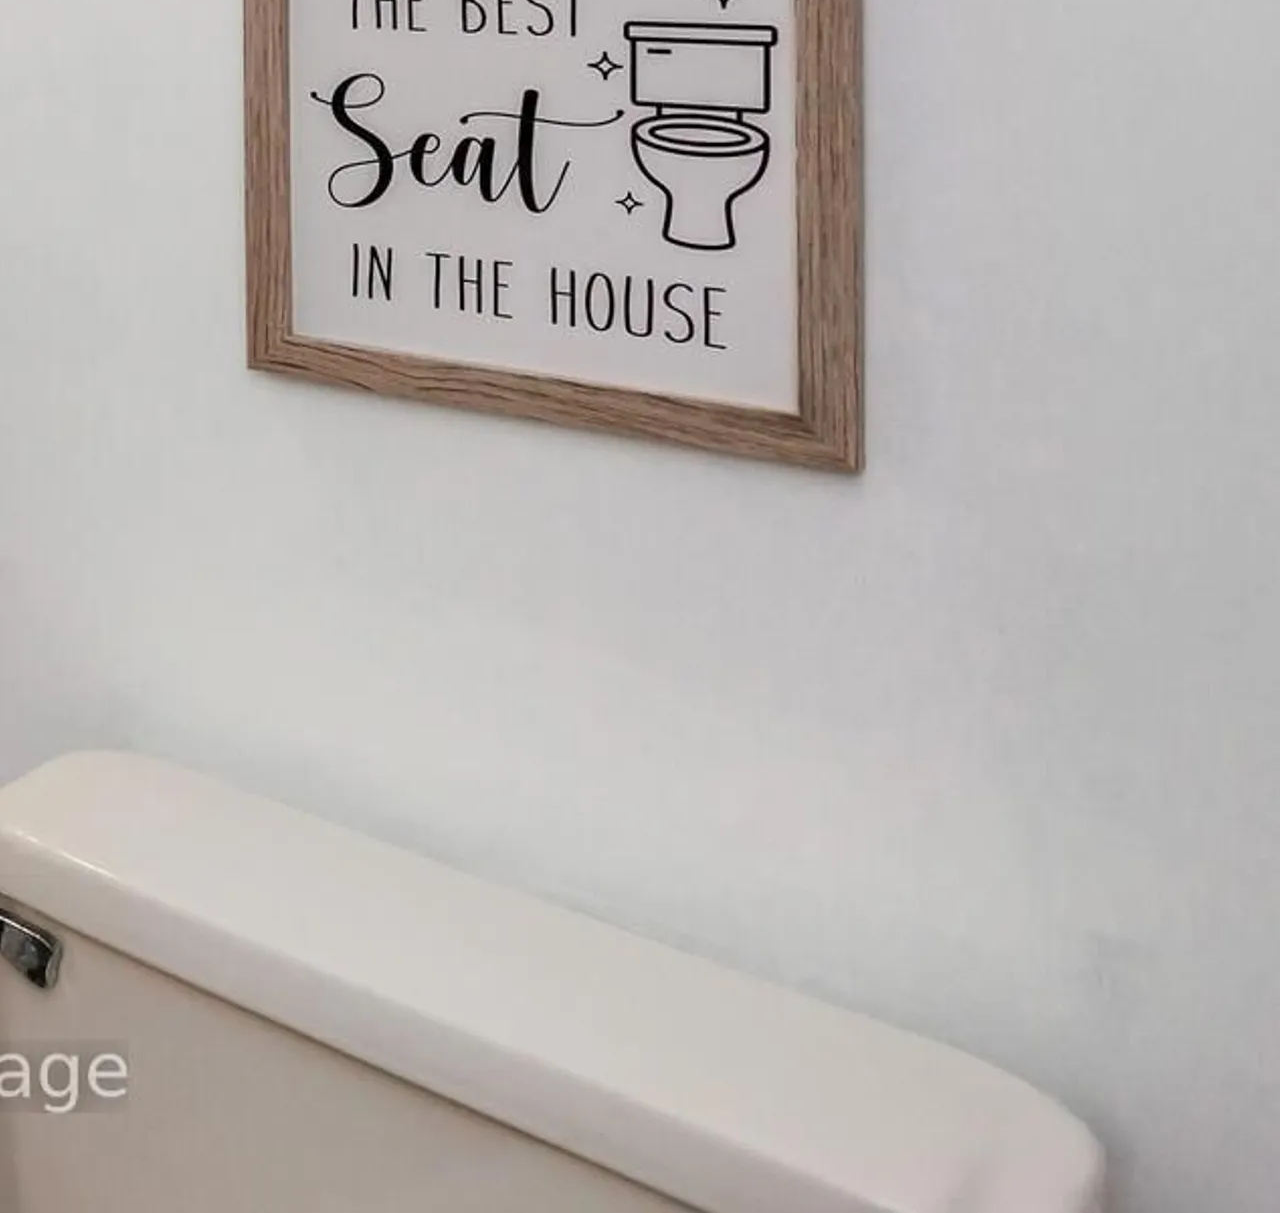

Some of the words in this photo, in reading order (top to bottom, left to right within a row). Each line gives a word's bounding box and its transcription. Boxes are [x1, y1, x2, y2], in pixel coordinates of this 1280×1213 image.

[309, 72, 626, 214] Seat
[351, 242, 394, 302] IN
[425, 252, 514, 320] THE
[550, 266, 729, 350] HOUSE
